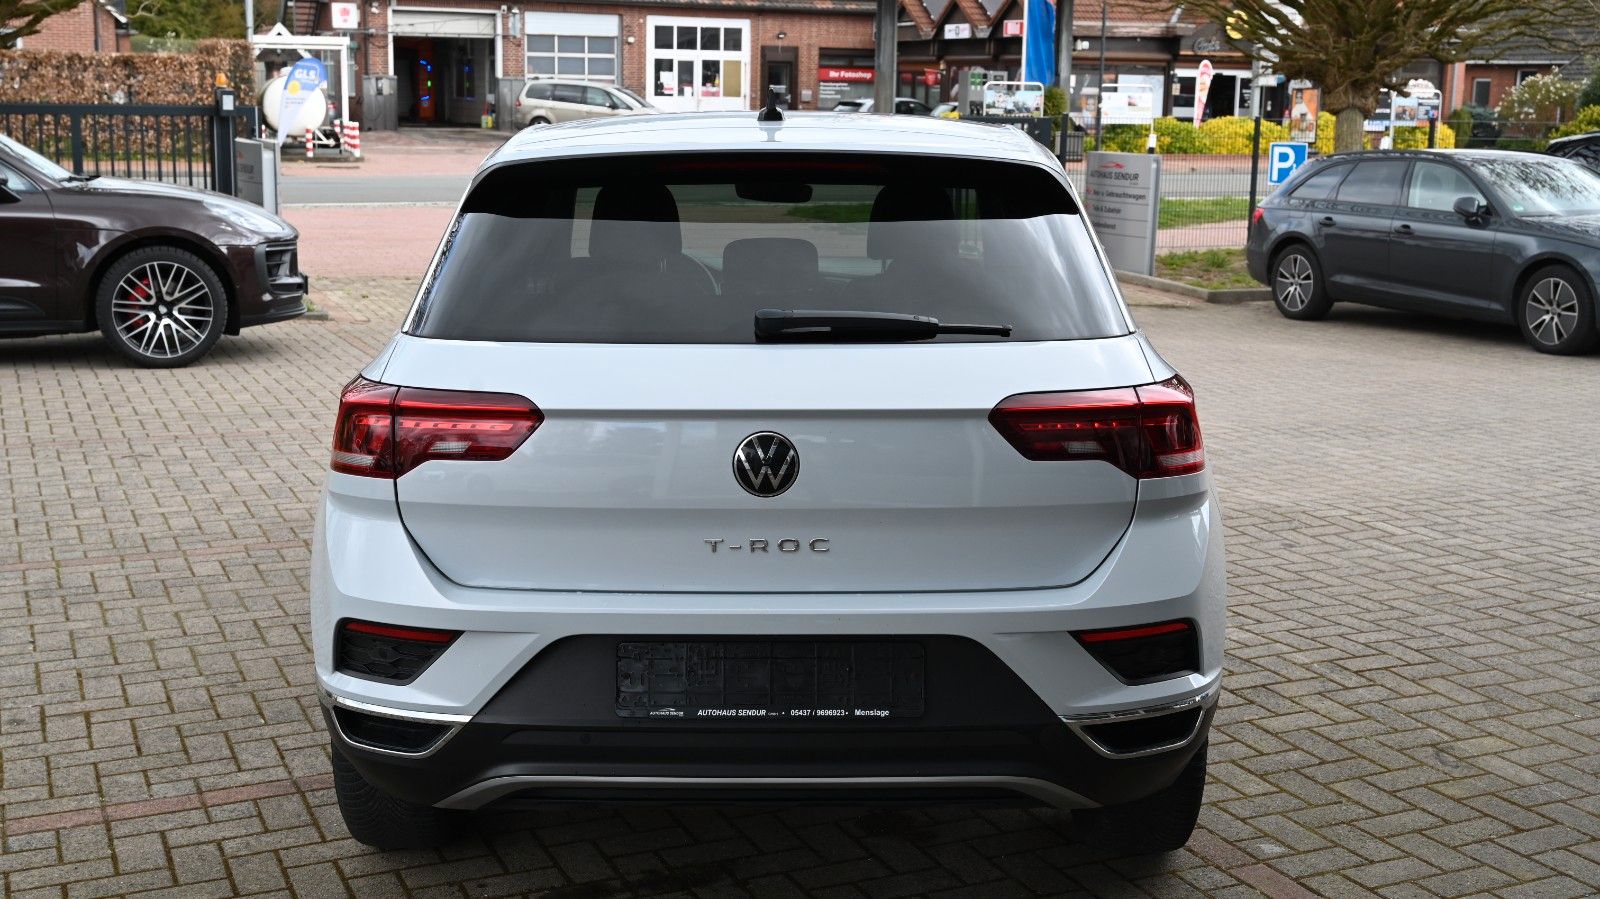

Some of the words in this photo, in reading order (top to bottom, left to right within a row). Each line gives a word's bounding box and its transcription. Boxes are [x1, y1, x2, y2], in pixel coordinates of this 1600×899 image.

[295, 69, 316, 79] GLS
[1272, 147, 1296, 181] P
[1114, 172, 1139, 180] SENDUR
[704, 537, 830, 553] T-ROC
[854, 708, 890, 718] Menslage
